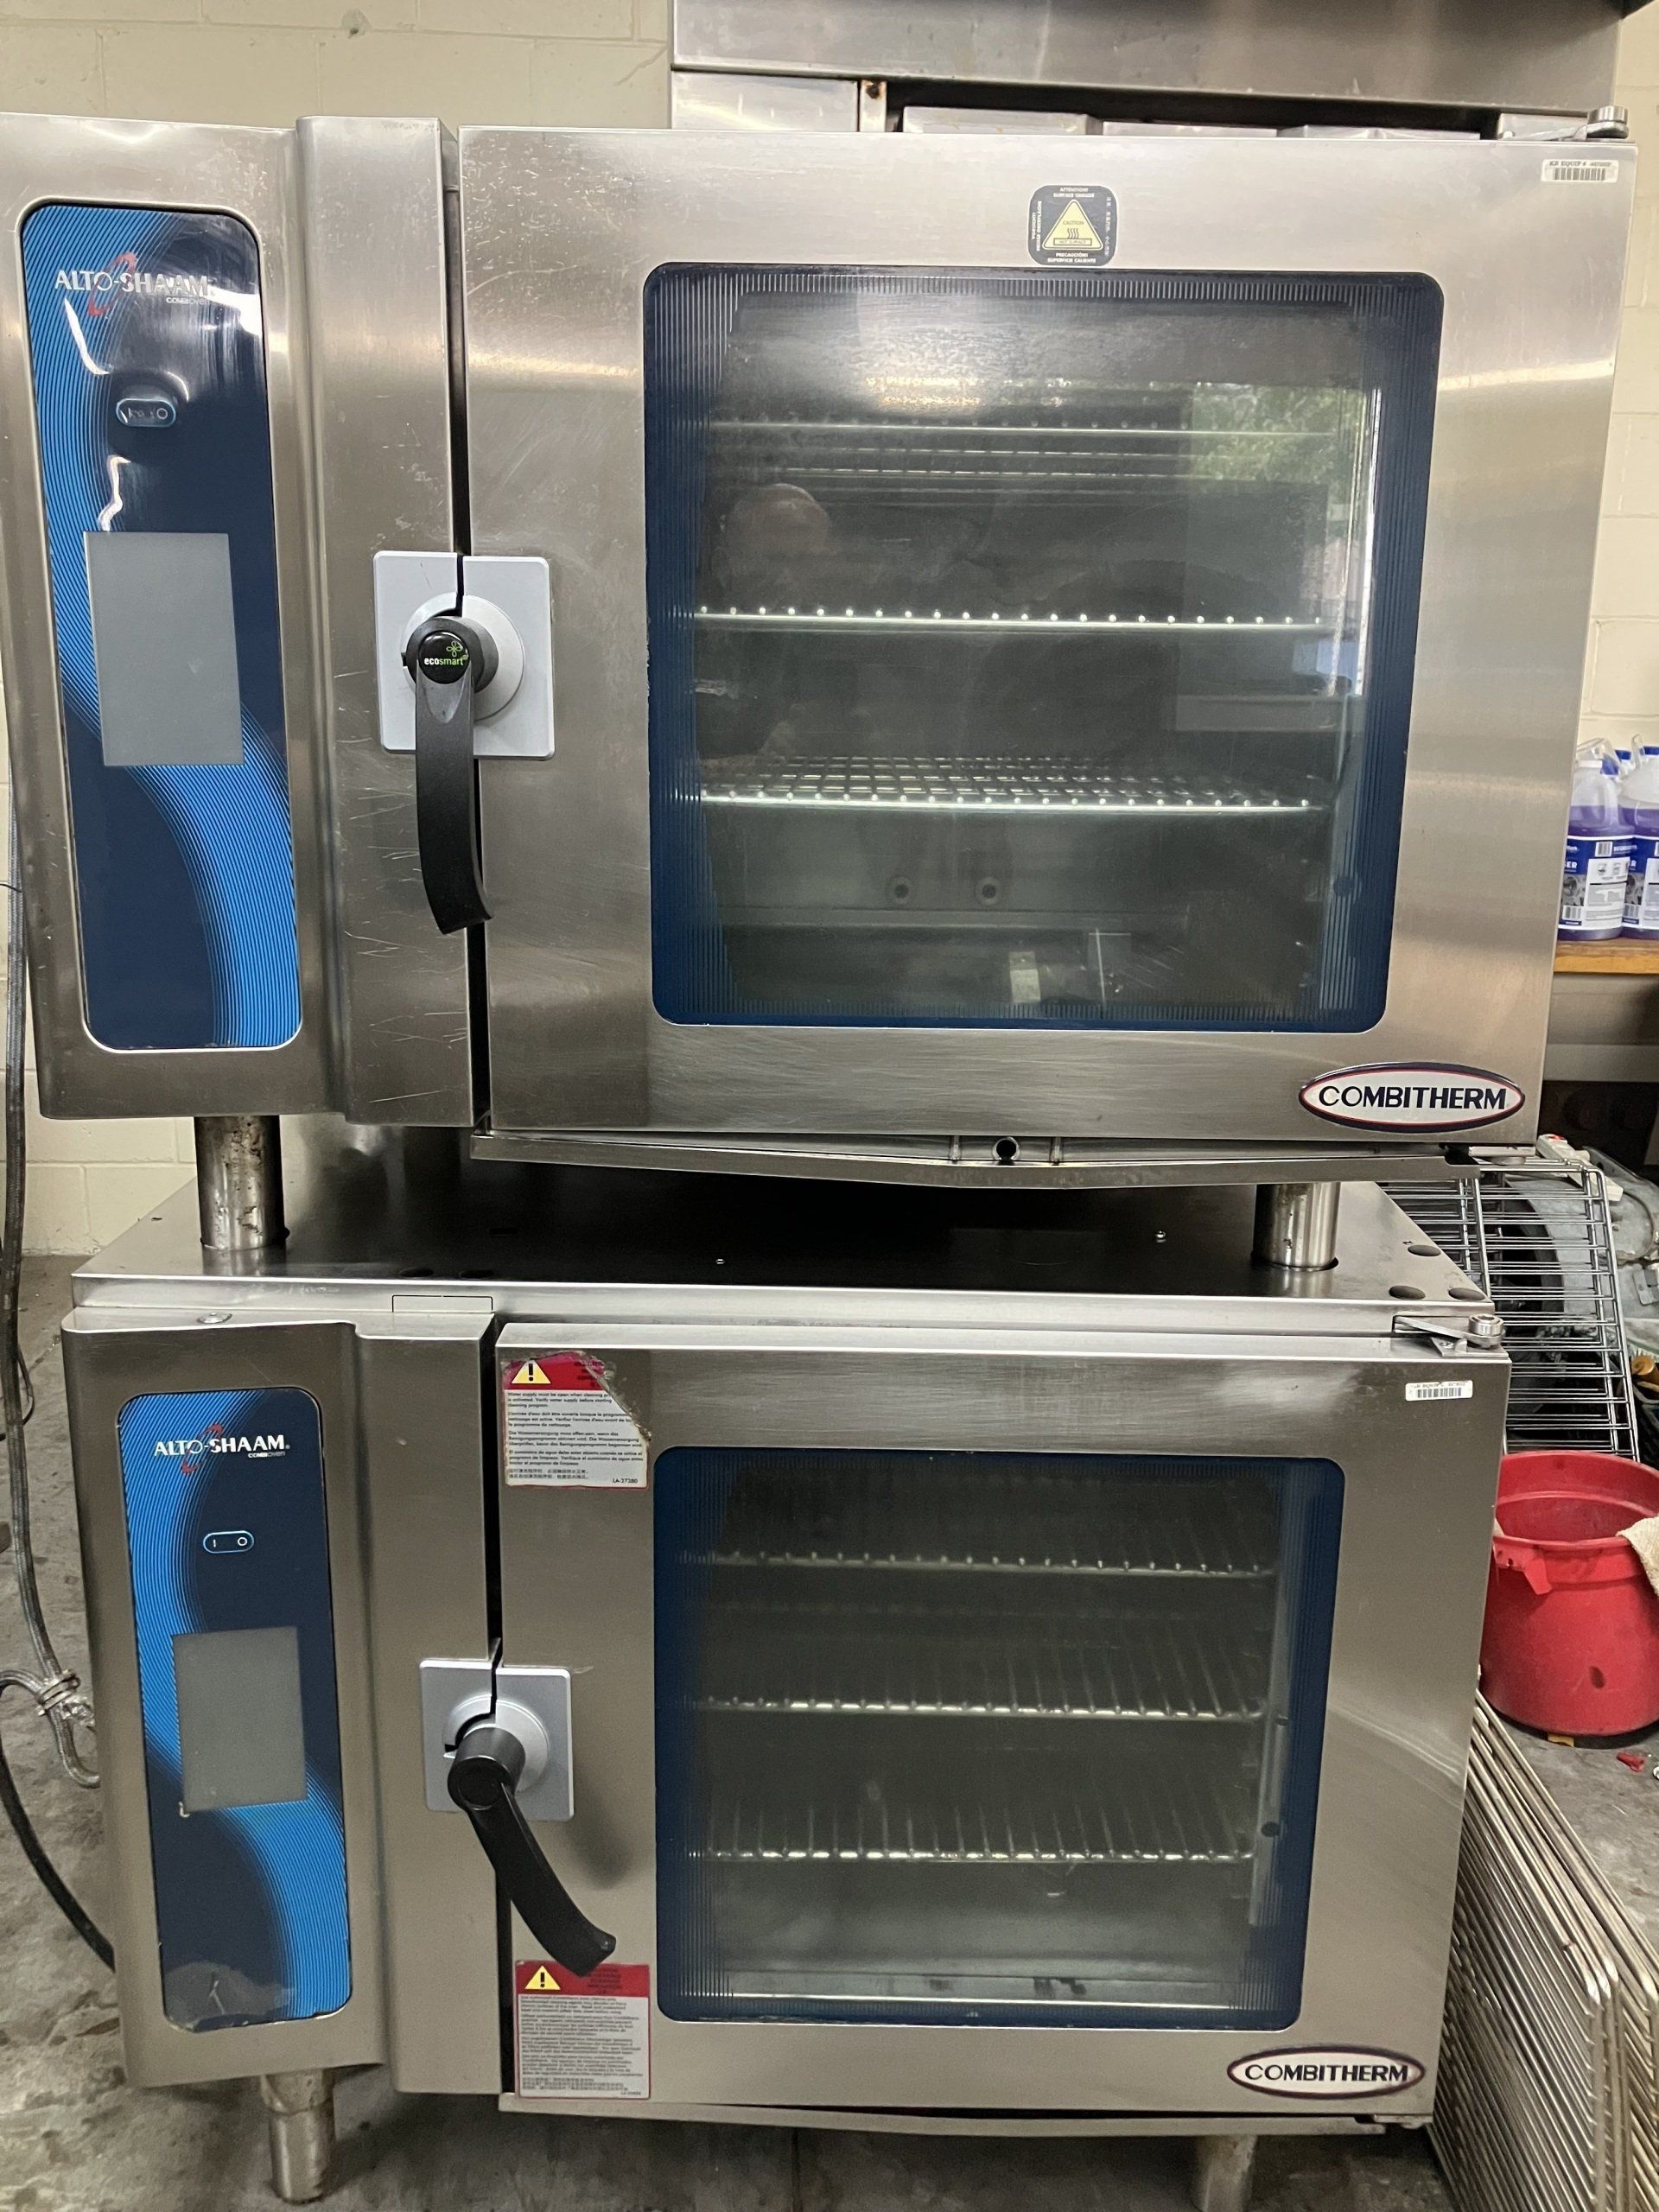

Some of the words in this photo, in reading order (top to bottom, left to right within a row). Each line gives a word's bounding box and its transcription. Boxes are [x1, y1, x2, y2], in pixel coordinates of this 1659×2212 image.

[423, 658, 464, 666] ecosmart
[1319, 1085, 1507, 1109] COMBITHERM
[154, 1434, 285, 1456] ALTO-SHAAM
[1245, 2064, 1408, 2082] COMBITHERM
